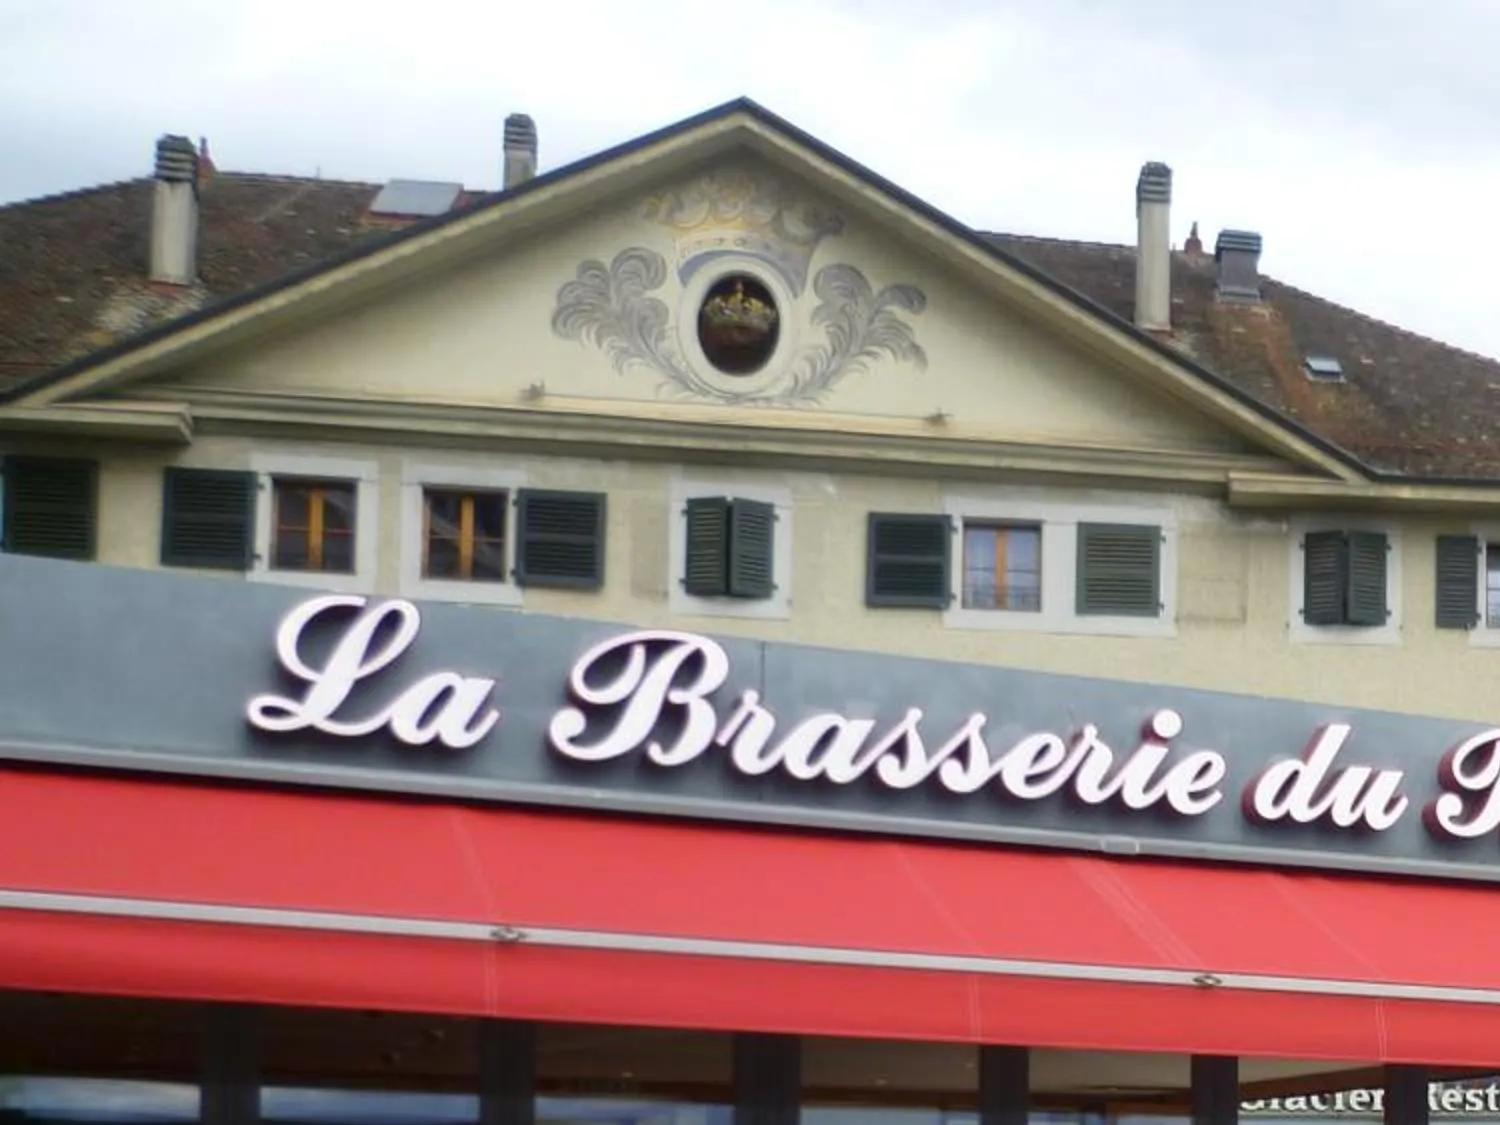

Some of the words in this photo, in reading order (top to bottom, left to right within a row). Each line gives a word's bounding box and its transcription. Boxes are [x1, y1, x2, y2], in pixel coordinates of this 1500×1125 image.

[247, 594, 500, 748] La
[548, 628, 1226, 816] Brasserie
[1253, 720, 1409, 831] du
